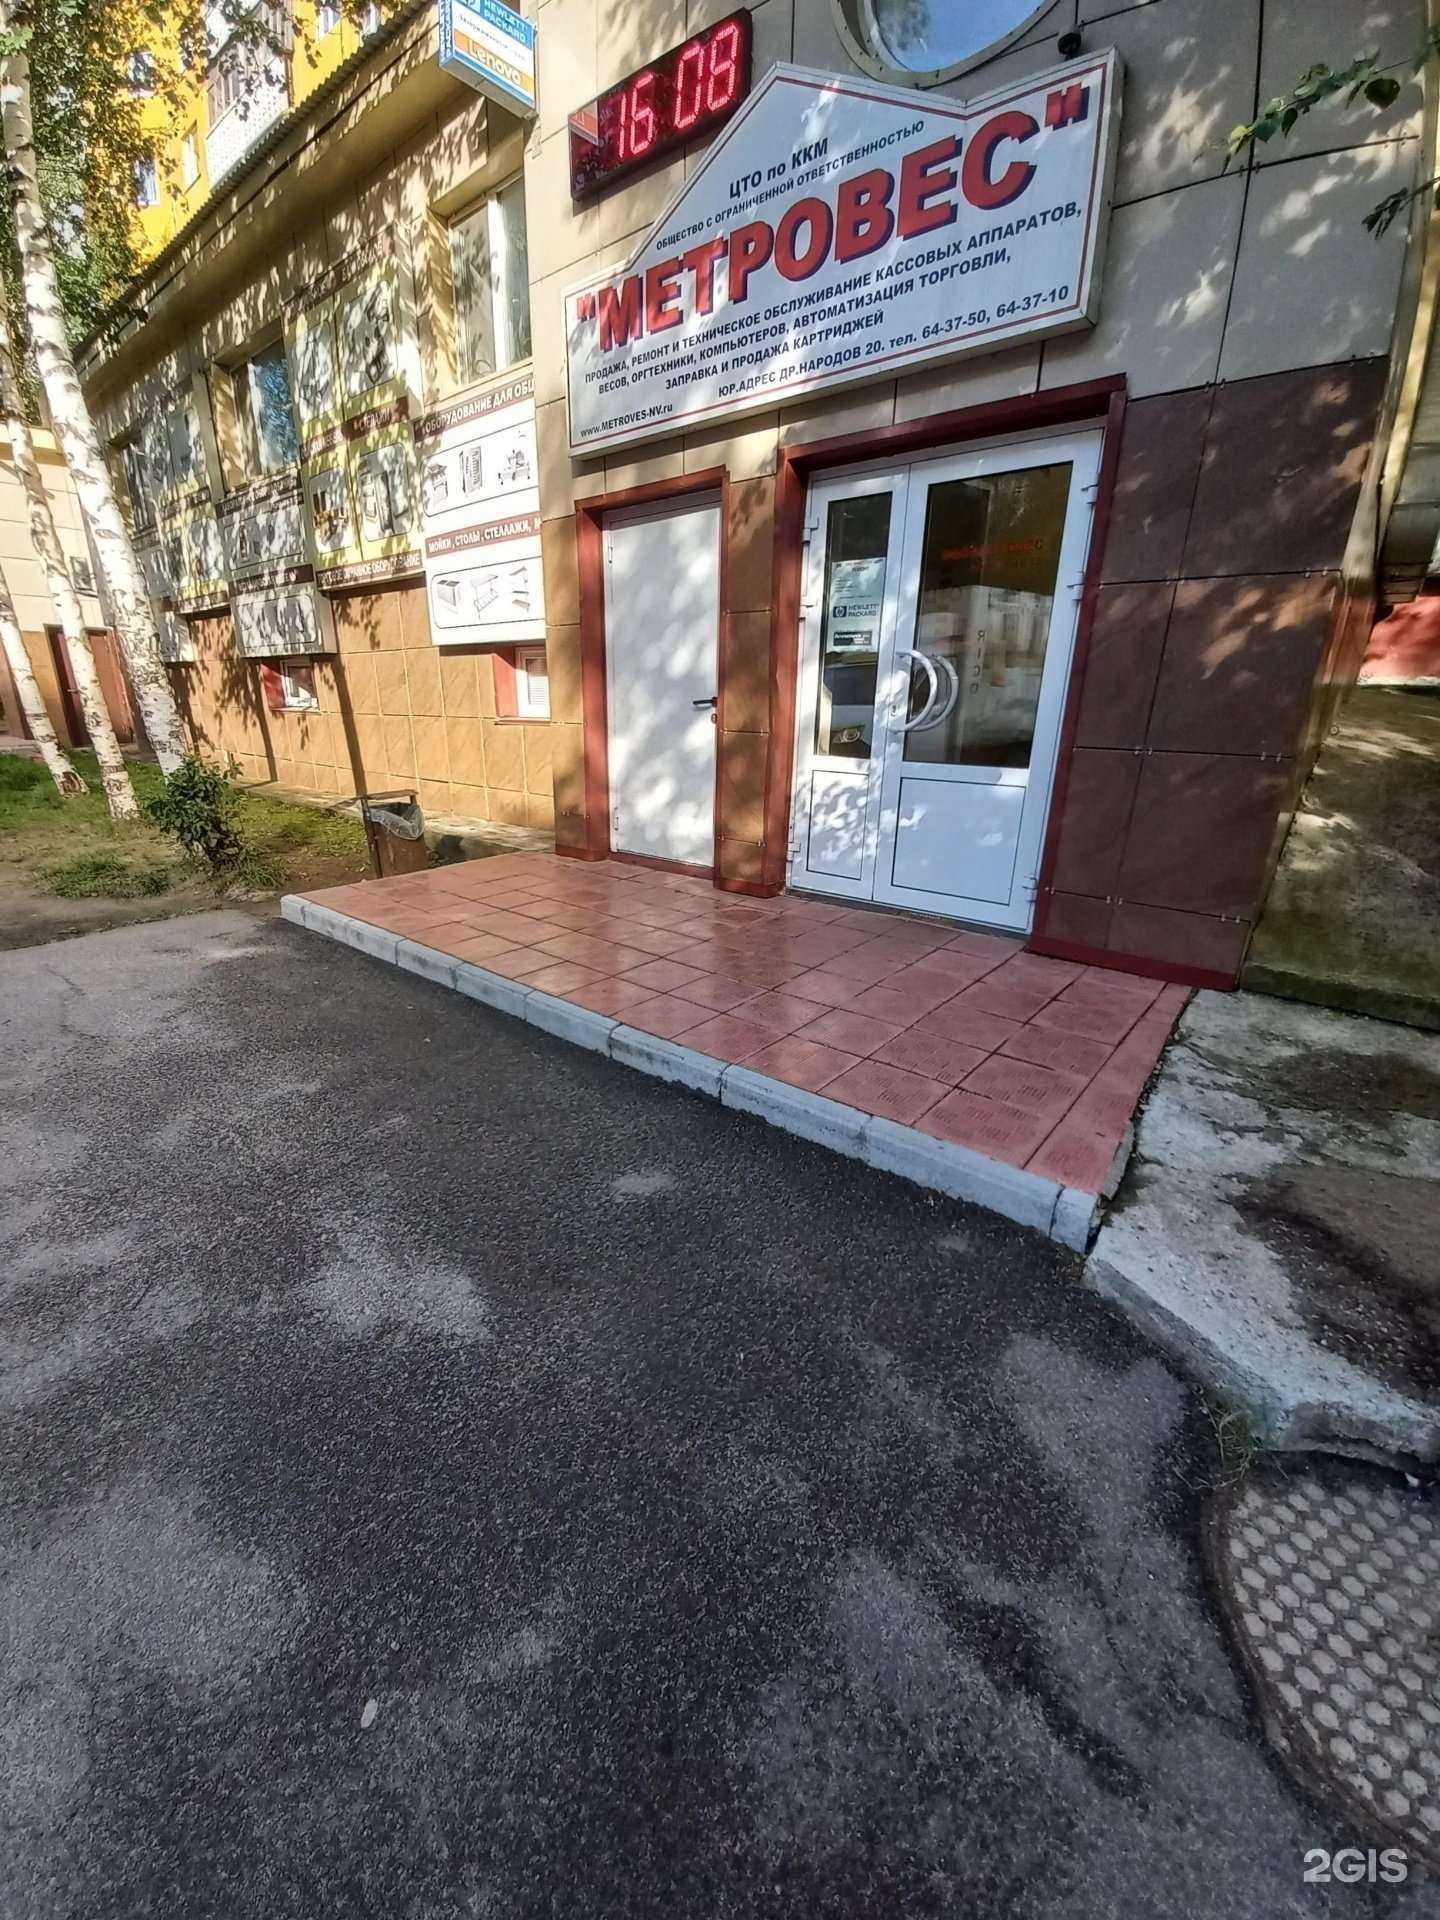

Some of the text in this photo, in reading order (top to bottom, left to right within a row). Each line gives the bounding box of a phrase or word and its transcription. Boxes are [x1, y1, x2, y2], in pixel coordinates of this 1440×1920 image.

[484, 8, 526, 43] PACKARD
[468, 39, 520, 84] Lenovo
[656, 221, 704, 250] ОБЩЕСТВО
[715, 179, 794, 224] ОГРАНИЧЕННОЙ
[796, 120, 925, 187] ОТВЕТСТВЕННОСТЬЮ
[729, 137, 829, 199] ЦТО по ККМ
[576, 82, 1091, 353] "МЕТРОВЕС"
[585, 201, 1082, 384] ПРОДАЖА, РЕМОНТ И ТЕХНИЧЕСКОЕ ОБСЛУЖИВАНИЕ КАССОВЫХ АППАРАТОВ,
[598, 248, 1011, 395] ВЕСОВ, ОРГТЕХНИКИ, КОМПЬЮТЕРОВ, АВТОМАТИЗАЦИЯ ТОРГОВЛИ,
[665, 309, 885, 390] ЗАПРАВКА И ПРОДАЖА КАРТРИДЖЕЙ
[718, 285, 1069, 398] ЮР.АДРЕС ДР.НАРОДОВ 20. тел. 64-37-50, 64-37-10
[425, 397, 492, 435] ОБОРУДОВАНИЕ
[492, 388, 514, 408] ДЛЯ
[580, 403, 674, 438] www.METROVES-NV.ru
[848, 603, 879, 611] HEWLETT
[848, 609, 877, 617] PACKARD
